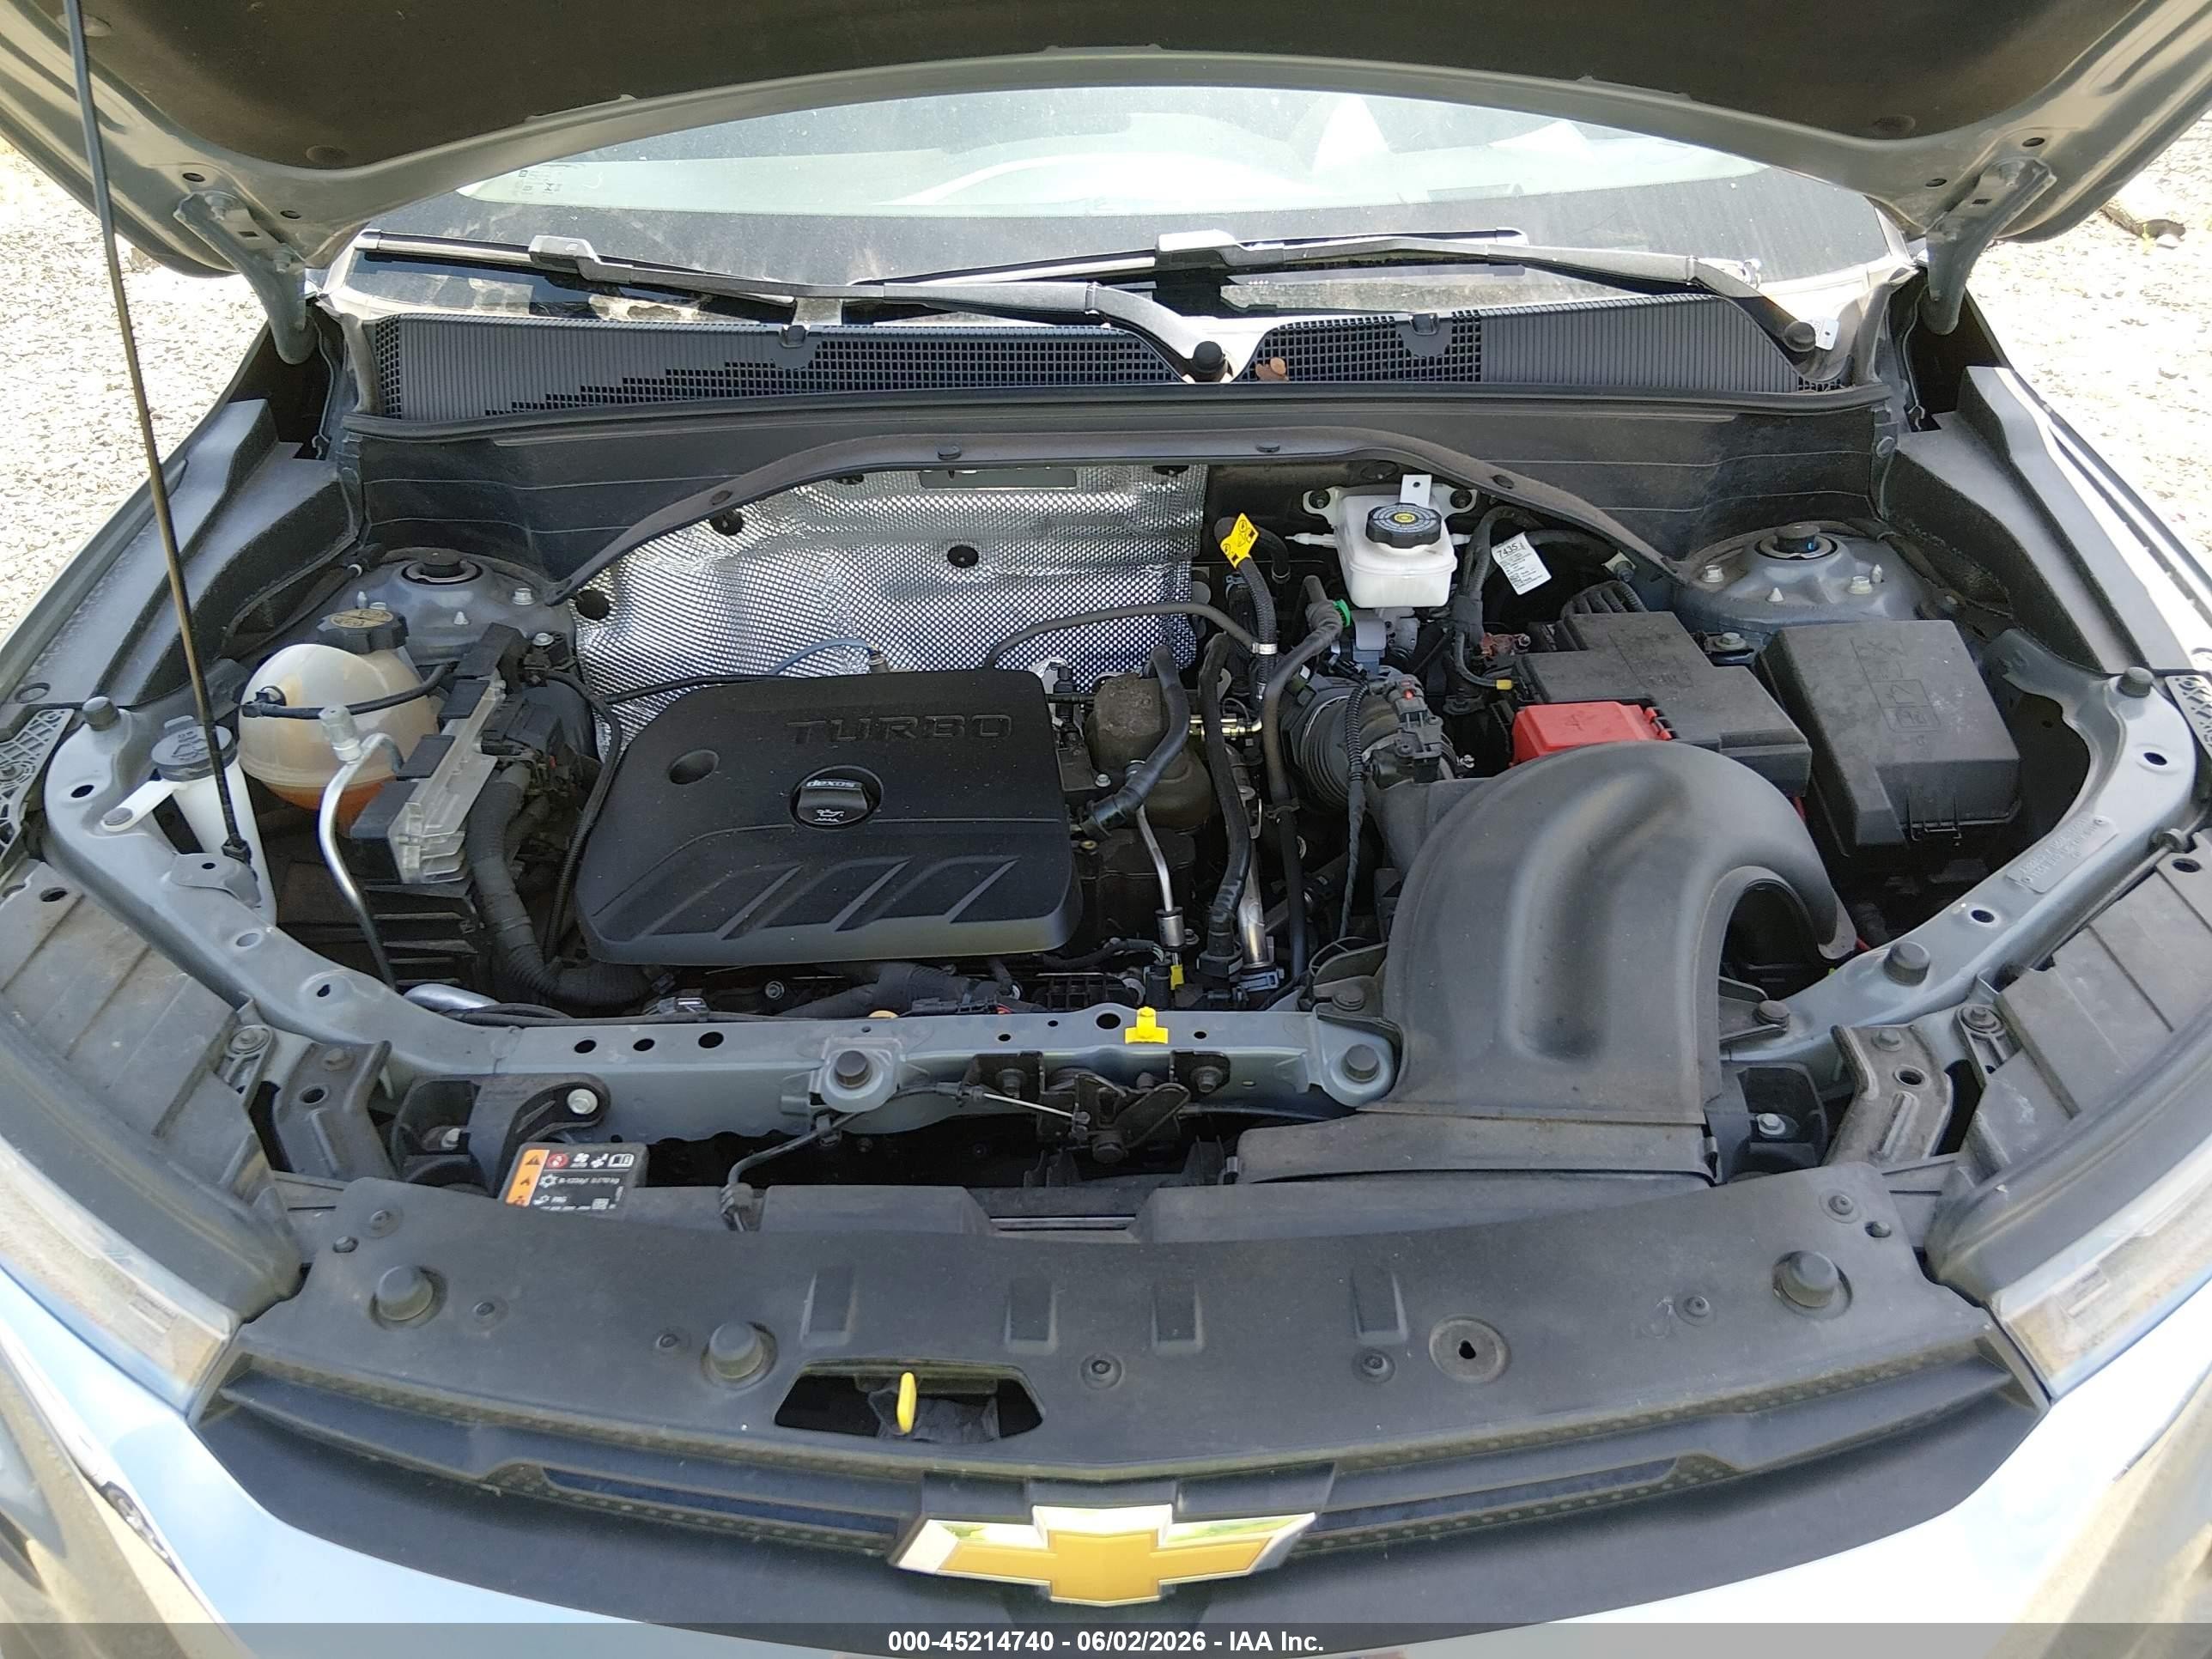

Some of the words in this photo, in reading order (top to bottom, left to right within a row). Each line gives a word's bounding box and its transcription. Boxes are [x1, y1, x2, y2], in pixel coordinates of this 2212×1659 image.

[1497, 543, 1518, 558] 7435
[786, 714, 1012, 744] TURBO
[806, 779, 855, 787] dexos
